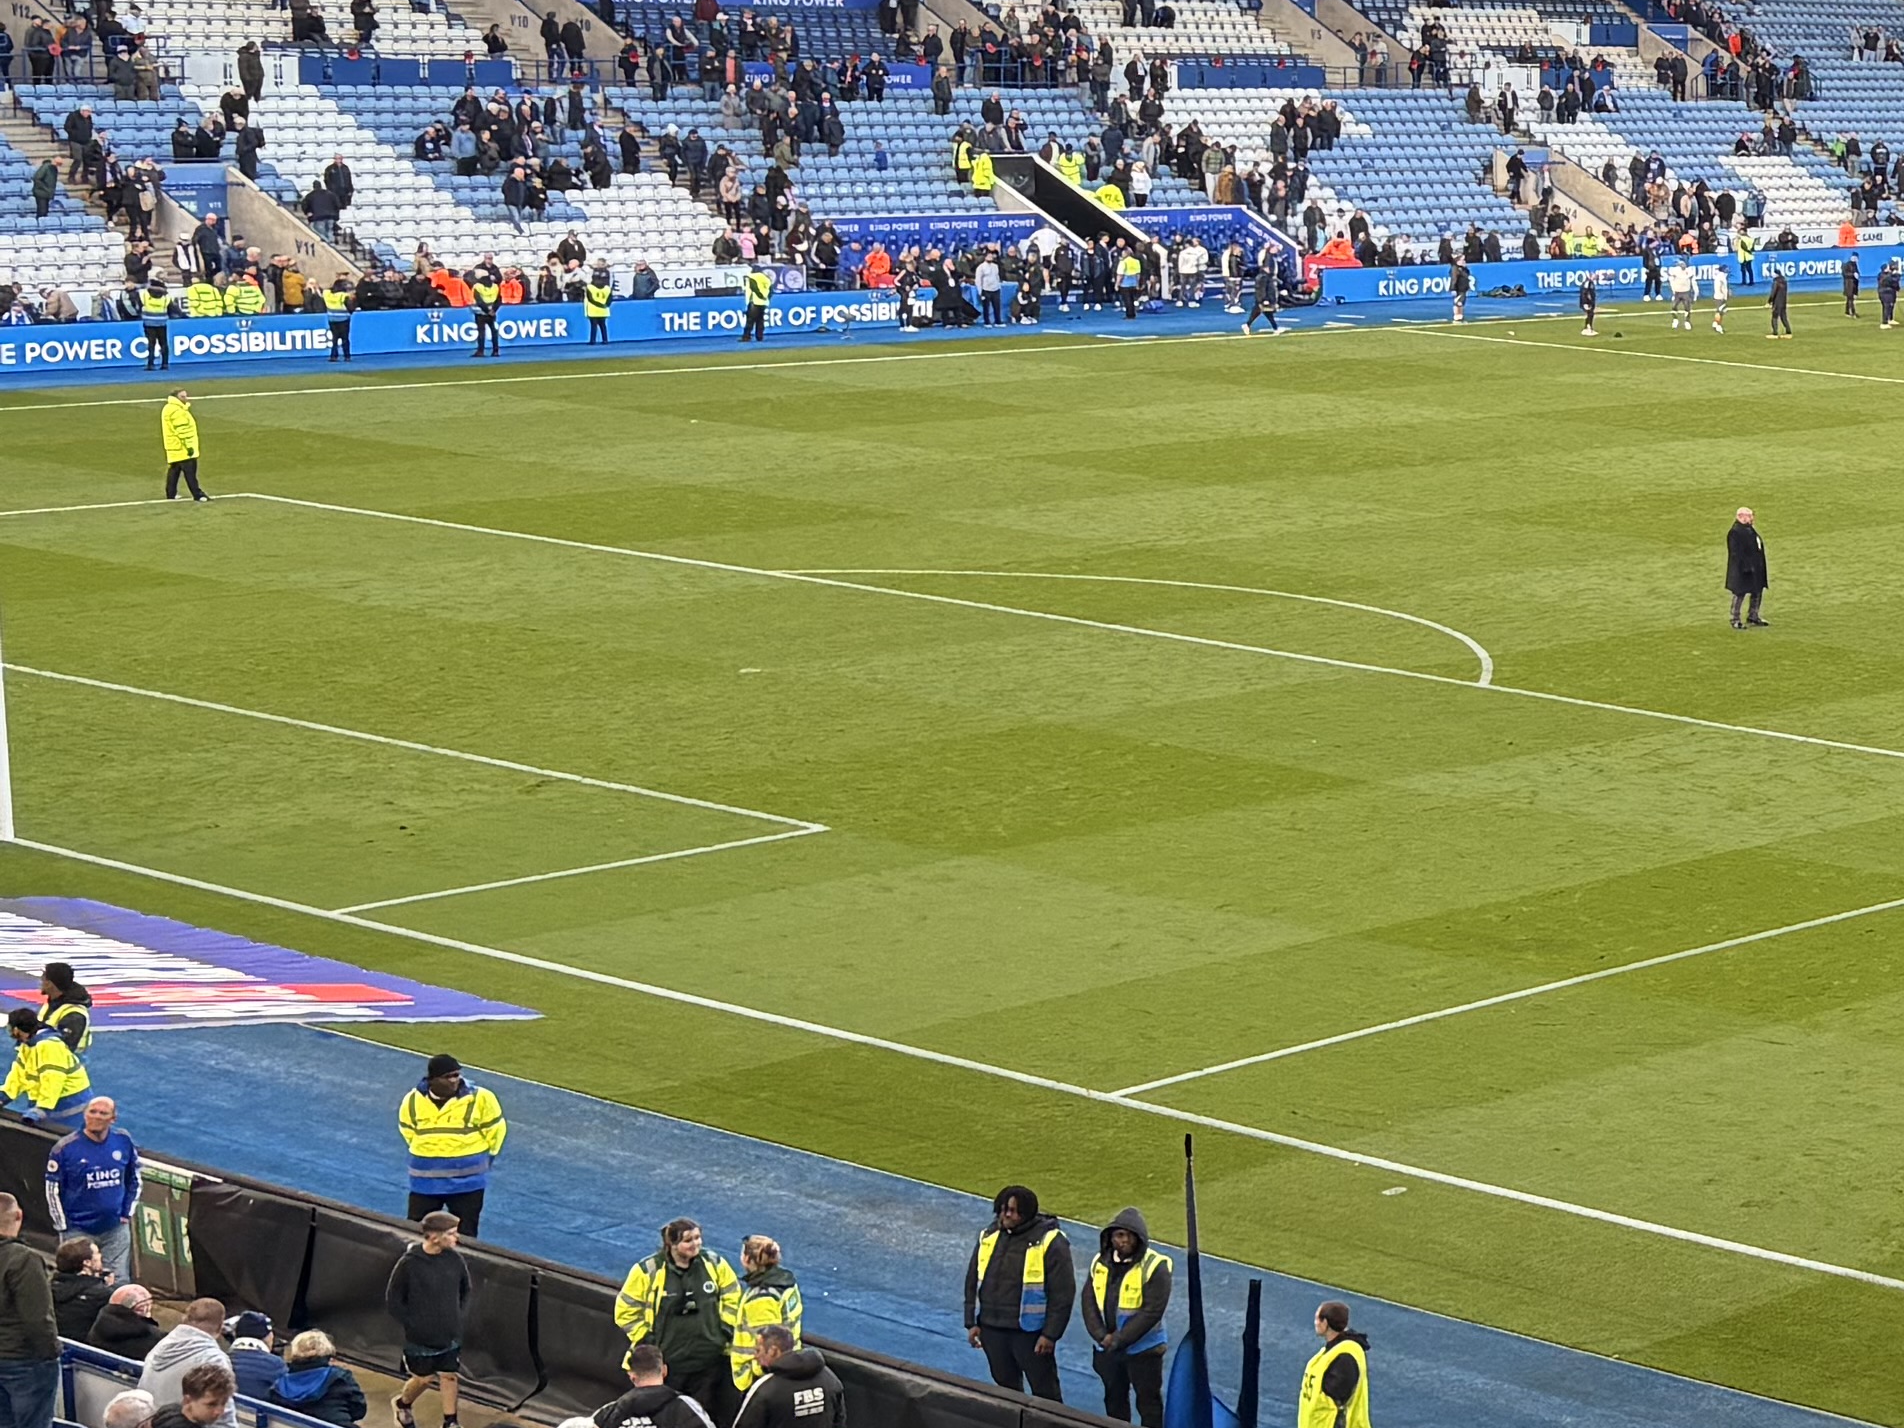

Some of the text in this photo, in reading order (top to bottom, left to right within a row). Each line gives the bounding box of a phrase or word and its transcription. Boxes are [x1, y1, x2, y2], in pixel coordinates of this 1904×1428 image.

[511, 14, 528, 28] V10
[294, 238, 315, 257] V11
[1536, 270, 1563, 288] THE
[1619, 267, 1638, 285] OF
[1762, 260, 1842, 277] KING POWER
[1378, 278, 1418, 297] KING
[662, 305, 816, 333] THE OF
[416, 317, 567, 344] KING OWER
[25, 338, 122, 364] POWER
[86, 1168, 120, 1181] KING
[794, 1387, 825, 1405] FBS
